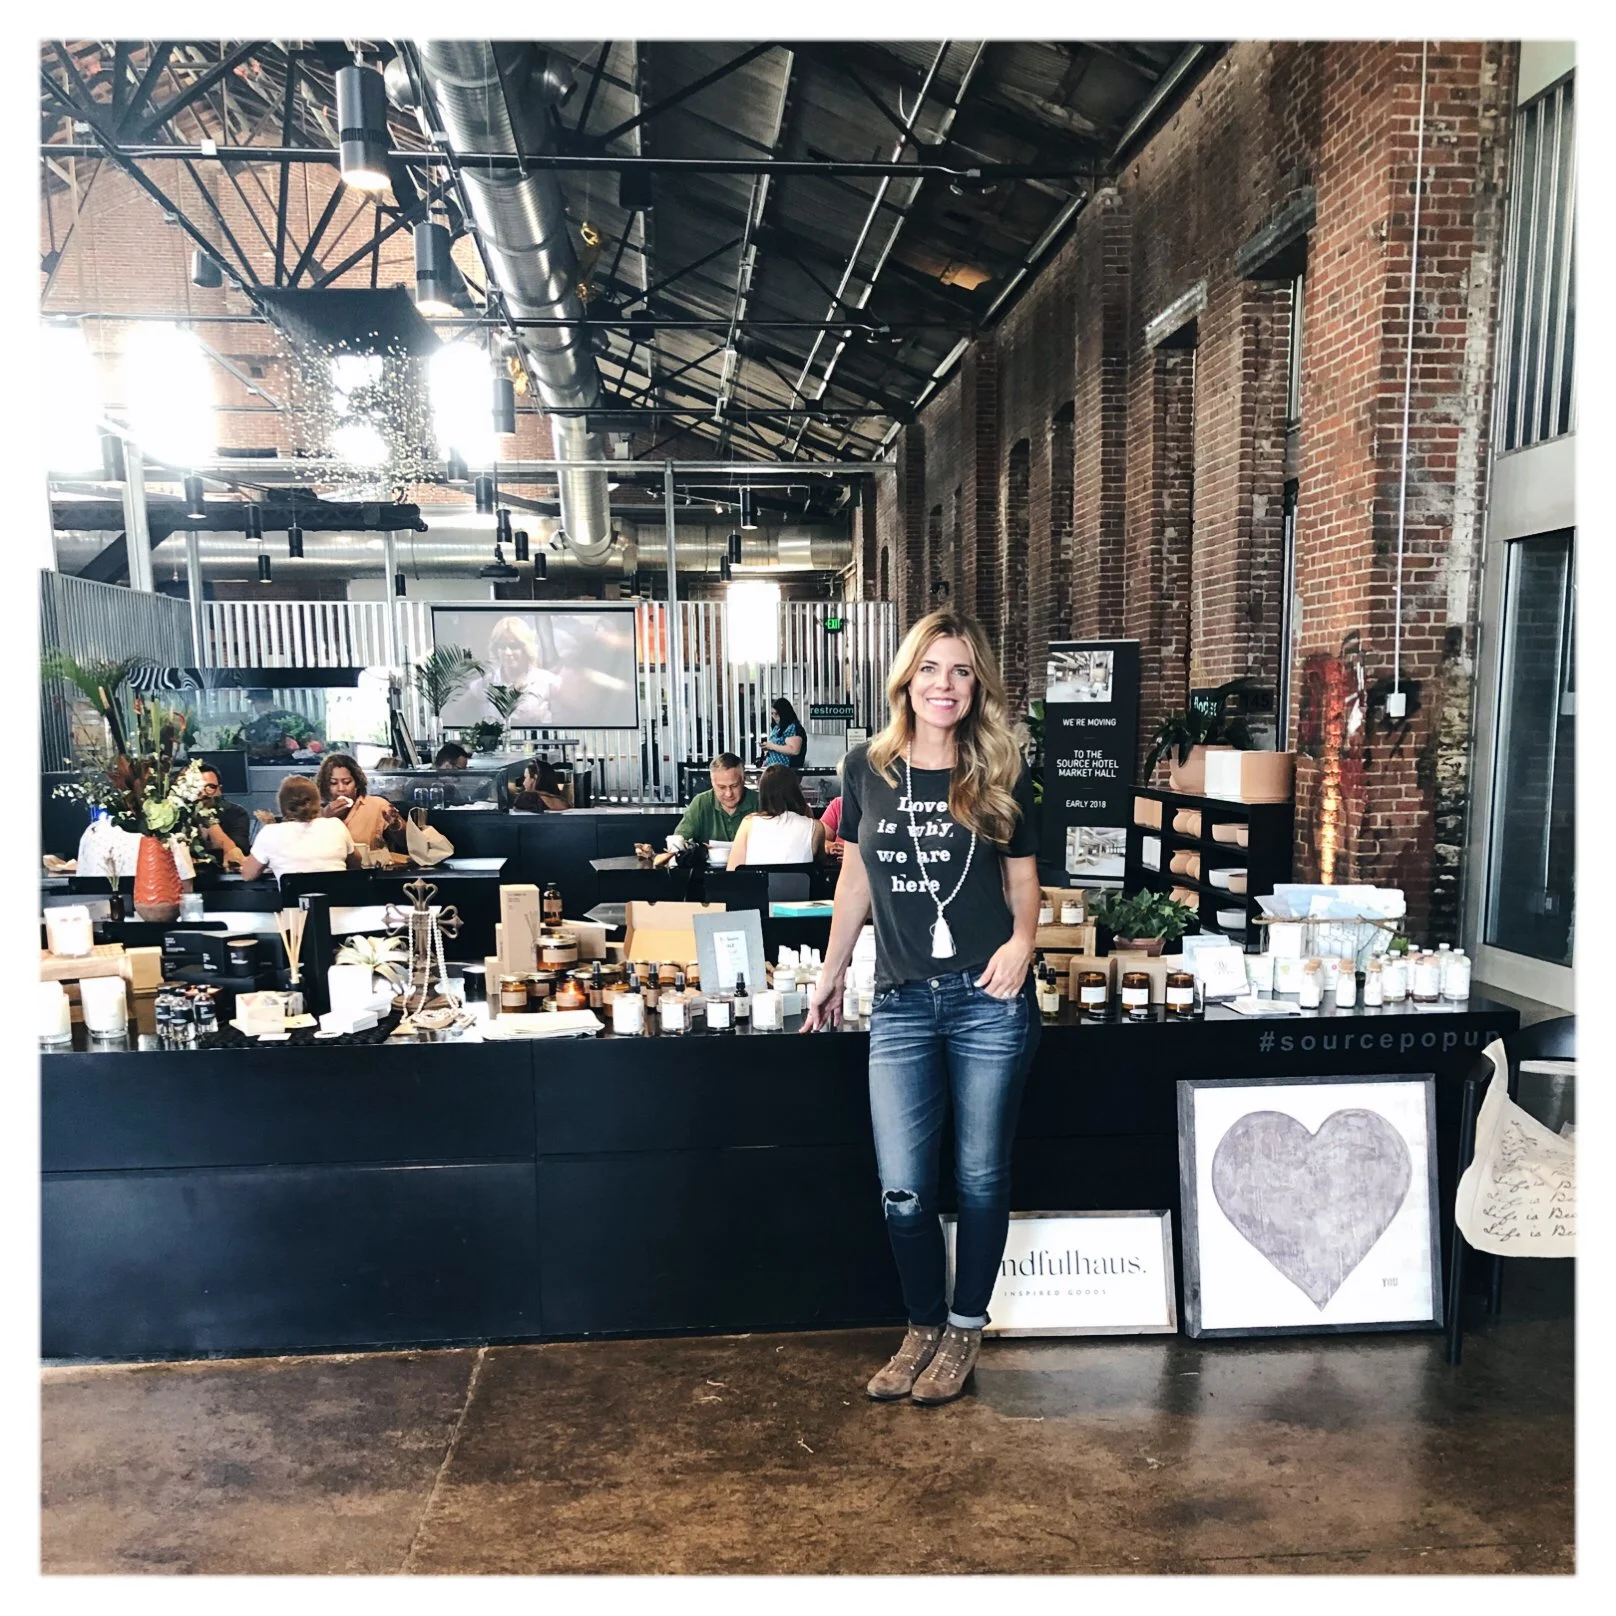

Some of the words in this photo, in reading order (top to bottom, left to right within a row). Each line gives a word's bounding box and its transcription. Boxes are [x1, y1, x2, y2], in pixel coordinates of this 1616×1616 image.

[827, 618, 841, 630] EXIT
[810, 705, 854, 714] restroom
[1062, 718, 1086, 727] WE'RE
[1087, 718, 1117, 727] MOVING
[1073, 749, 1085, 758] TO
[1086, 749, 1103, 759] THE
[1056, 759, 1090, 768] SOURCE
[1091, 759, 1119, 769] HOTEL
[1058, 768, 1092, 777] MARKET
[1094, 769, 1117, 778] HALL
[897, 796, 948, 813] Love
[1065, 800, 1088, 808] EARLY
[1089, 800, 1107, 809] 2018
[876, 818, 898, 834] is
[876, 849, 907, 864] we
[916, 848, 951, 864] are
[891, 874, 940, 893] here
[1483, 1222, 1521, 1242] Life
[1001, 1249, 1147, 1277] ndfulhaus.
